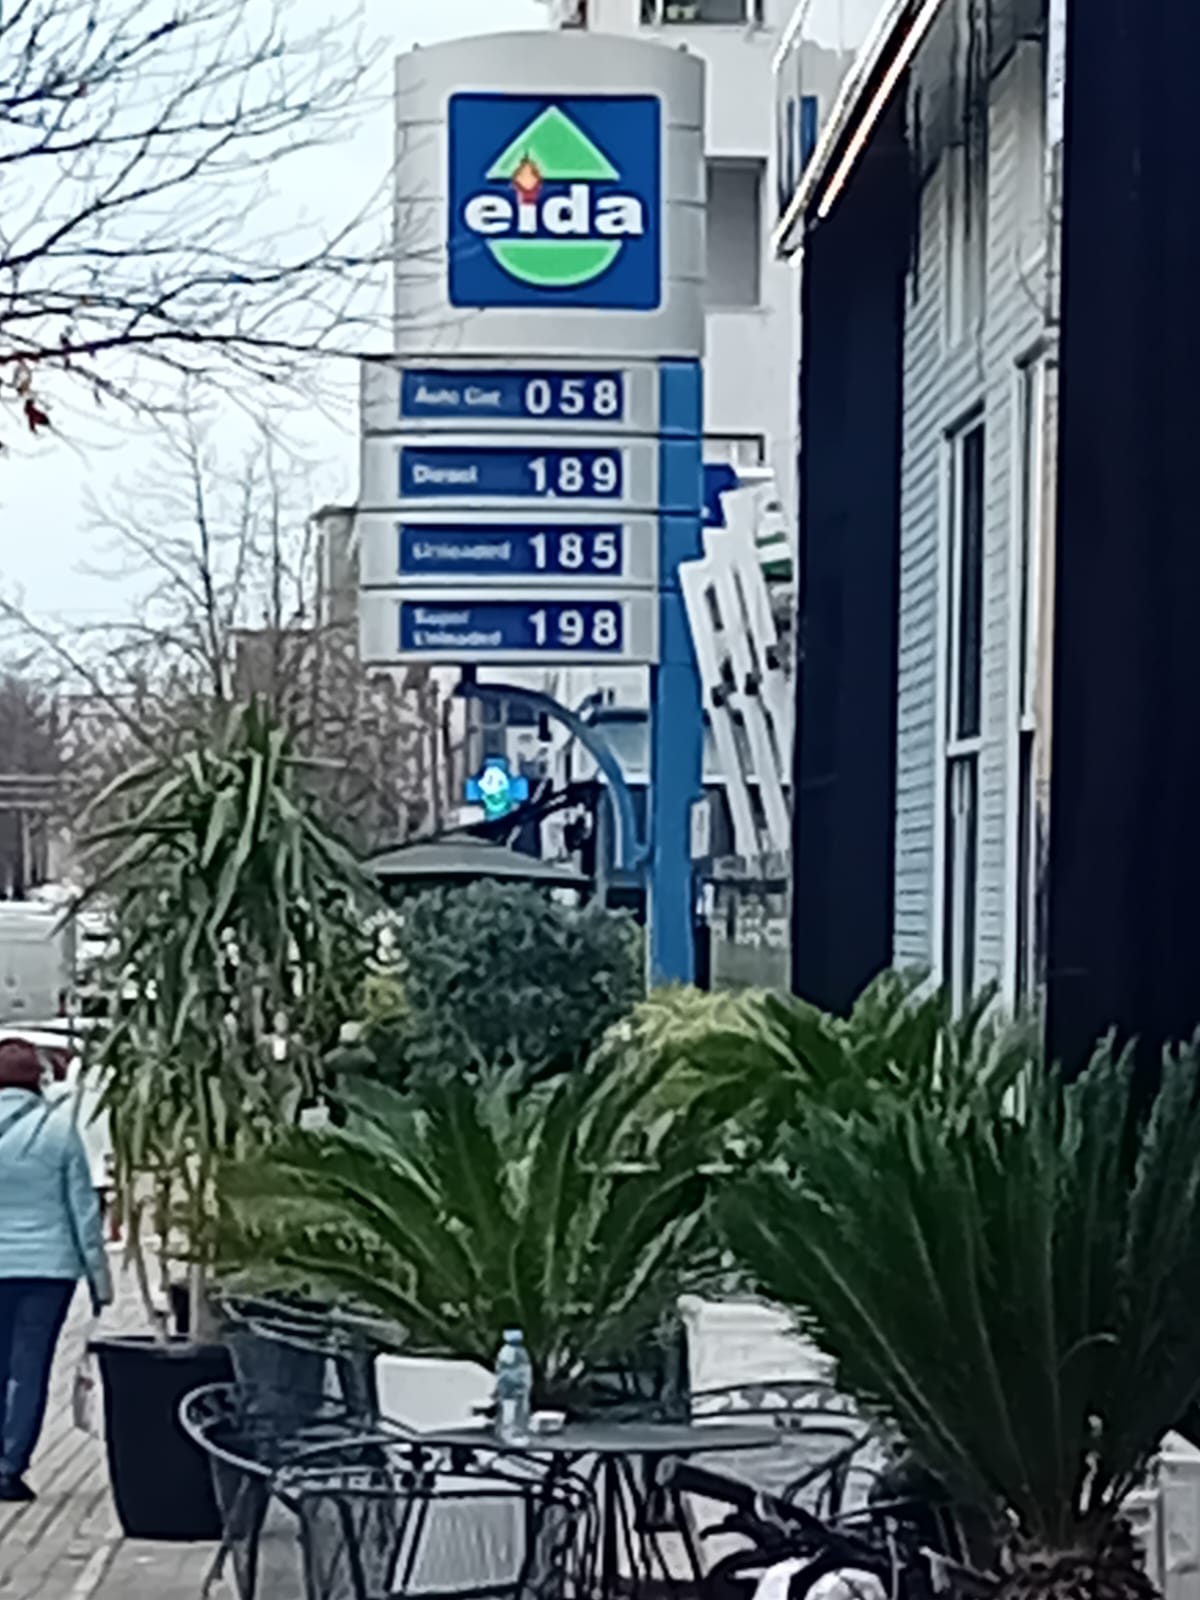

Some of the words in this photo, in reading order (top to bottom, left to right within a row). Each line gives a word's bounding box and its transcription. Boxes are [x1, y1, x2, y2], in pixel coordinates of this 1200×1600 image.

[464, 184, 644, 234] eida
[525, 379, 618, 415] 058
[412, 464, 478, 485] Diesel
[528, 532, 617, 569] 185
[528, 609, 617, 646] 198
